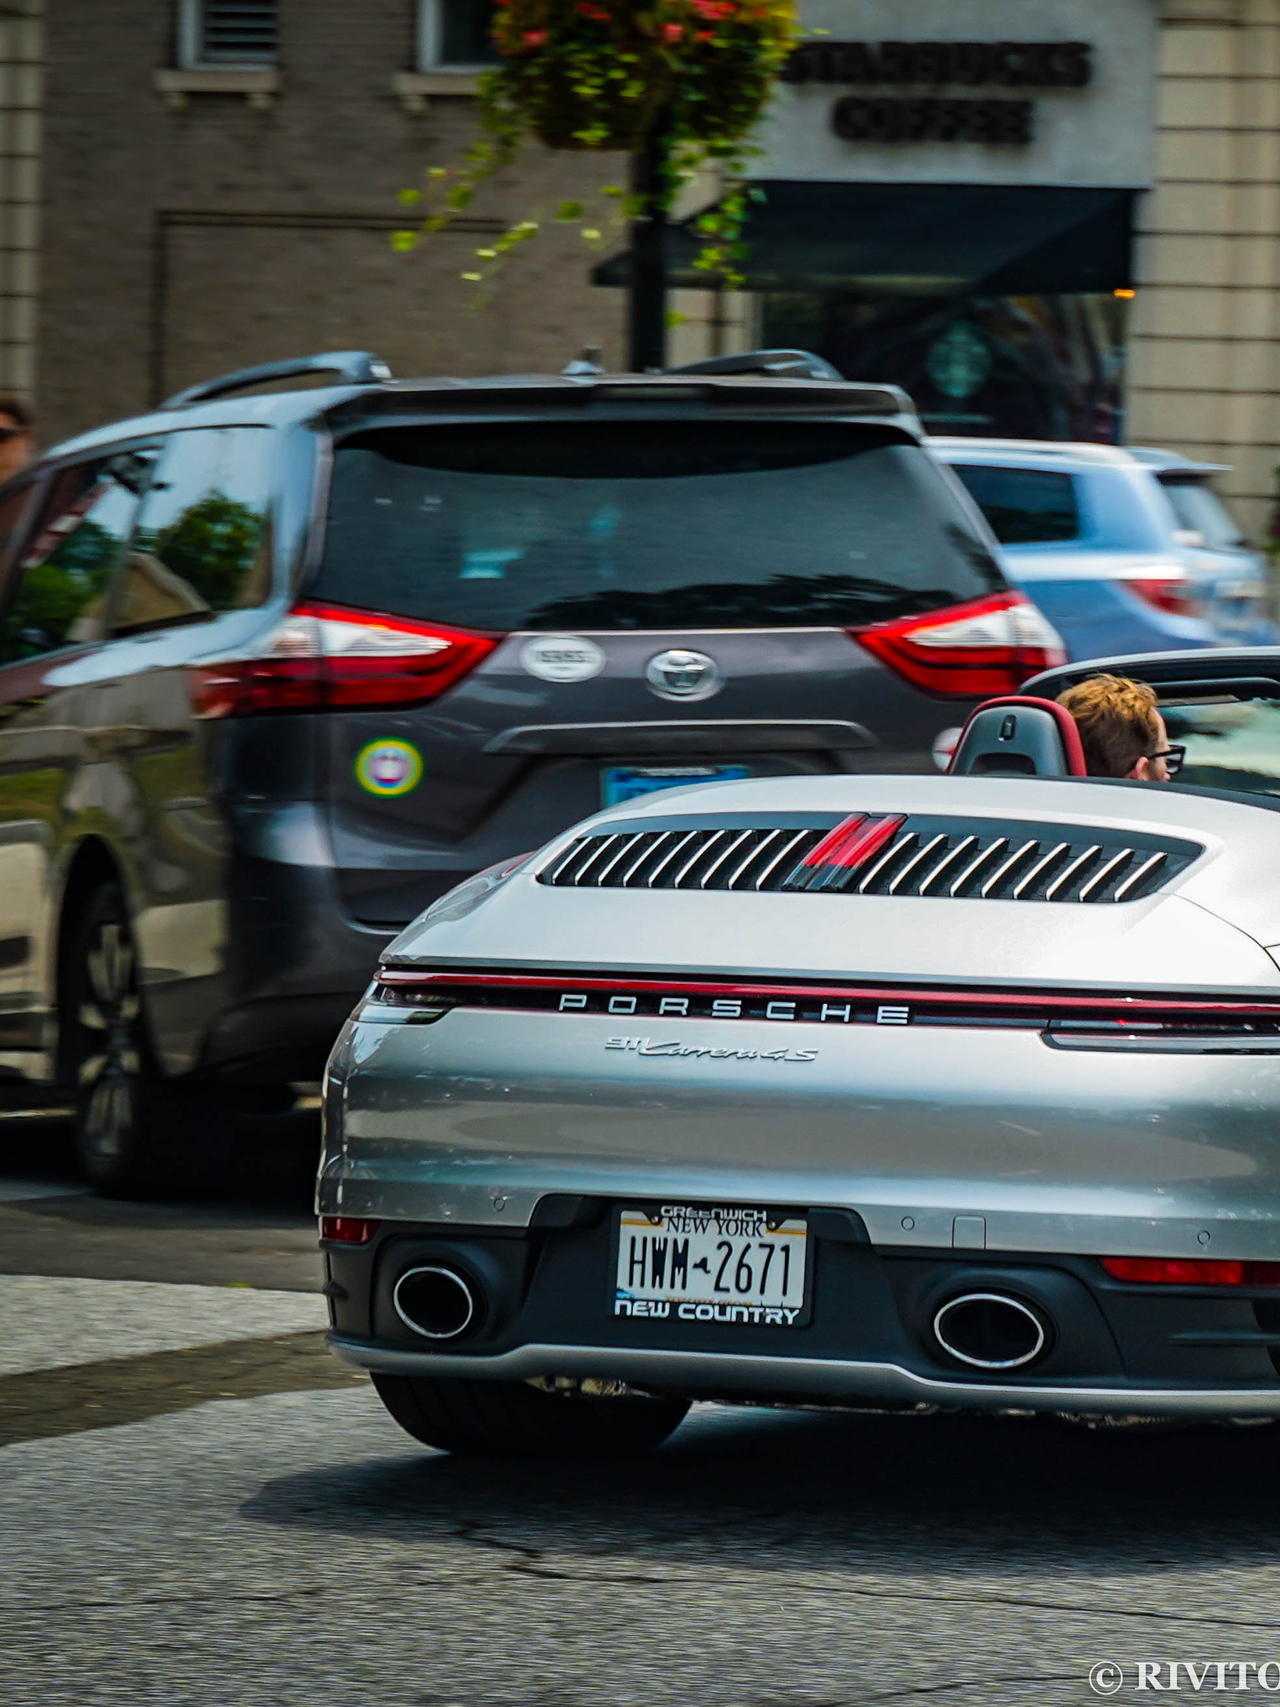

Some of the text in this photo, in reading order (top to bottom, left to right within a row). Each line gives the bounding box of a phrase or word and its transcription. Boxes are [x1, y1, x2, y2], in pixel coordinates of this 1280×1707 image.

[832, 98, 1032, 143] COFFEE
[559, 994, 909, 1024] PORSCHE
[604, 1035, 650, 1050] 911
[637, 1041, 760, 1059] Carrera
[661, 1205, 767, 1222] GREENWICH
[666, 1217, 764, 1238] NEW YORK
[628, 1235, 791, 1298] HWM 2671
[614, 1300, 671, 1318] NEW
[677, 1303, 800, 1326] COUNTRY
